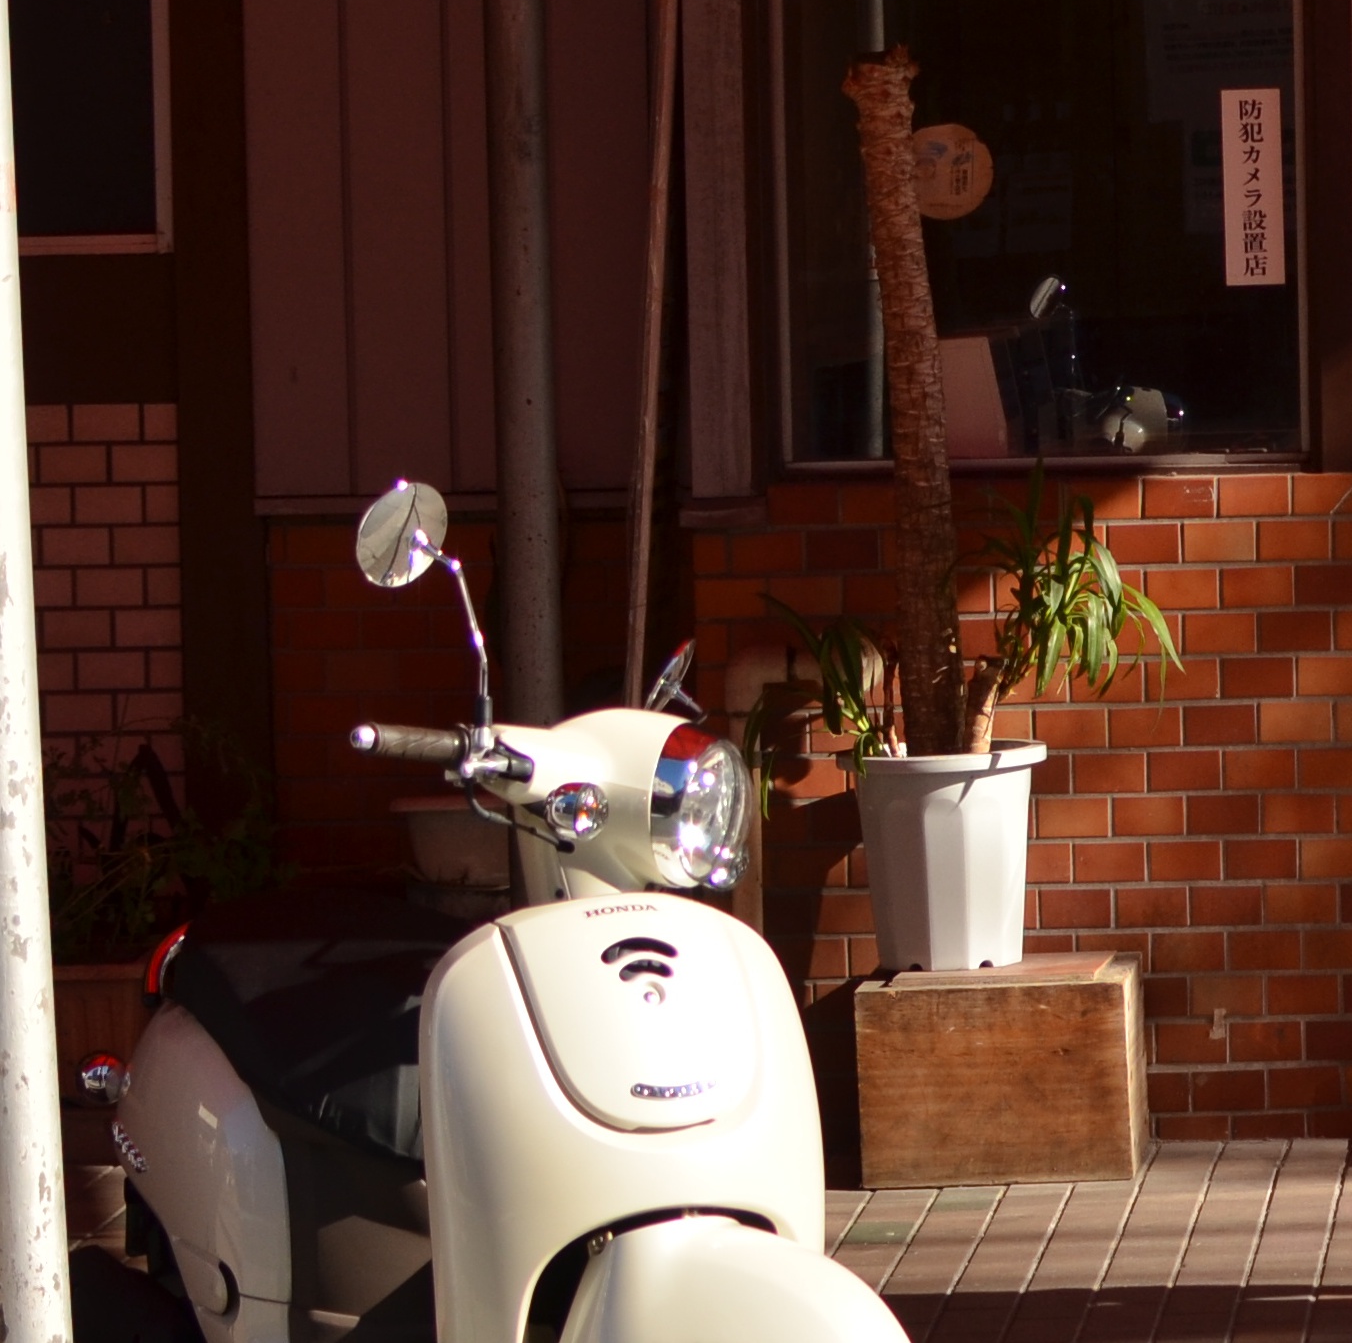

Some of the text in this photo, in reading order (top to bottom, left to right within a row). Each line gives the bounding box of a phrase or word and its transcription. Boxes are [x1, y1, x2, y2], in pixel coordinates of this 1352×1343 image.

[1238, 98, 1268, 277] 防犯カメラ設置店
[583, 904, 658, 919] HONDA
